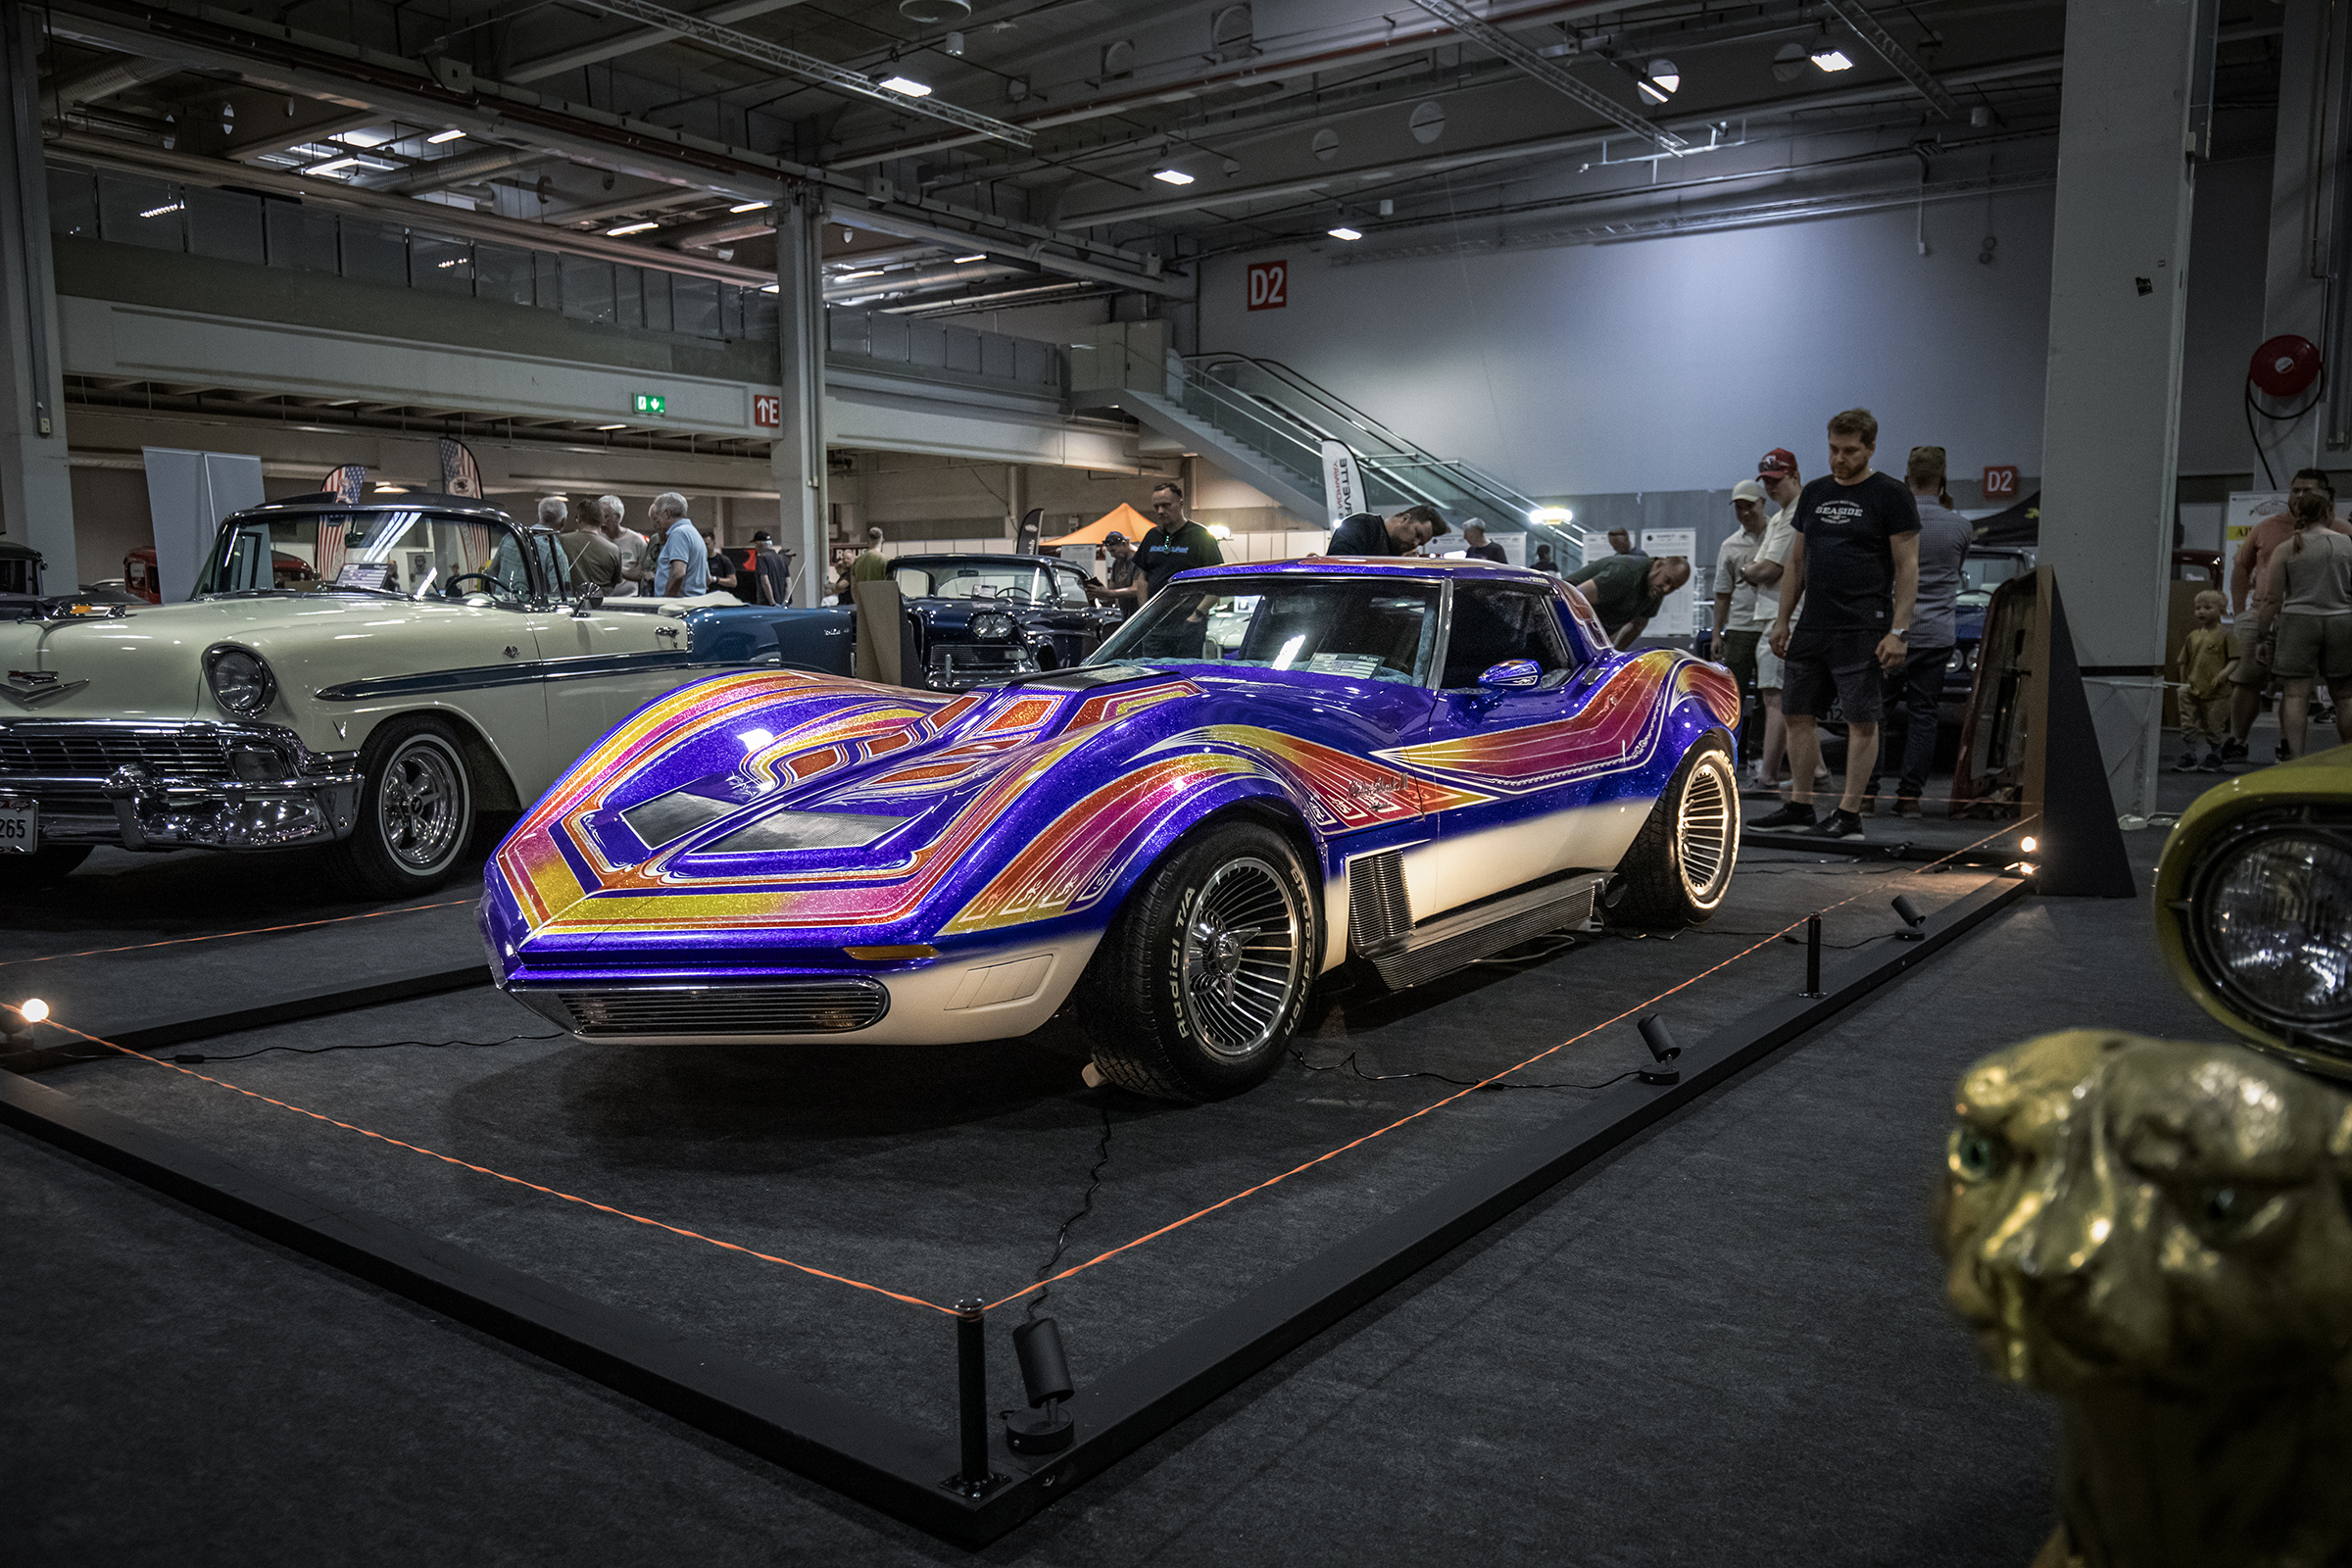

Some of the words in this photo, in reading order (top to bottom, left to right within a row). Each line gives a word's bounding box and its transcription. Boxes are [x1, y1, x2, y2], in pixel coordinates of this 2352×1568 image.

[1251, 267, 1284, 306] D2
[1987, 470, 2013, 492] D2
[1815, 506, 1863, 517] SEASIDE
[0, 818, 25, 838] 265
[1175, 888, 1196, 927] T/A
[1284, 867, 1312, 1036] BFGoodrich
[1169, 938, 1190, 1039] Radial
